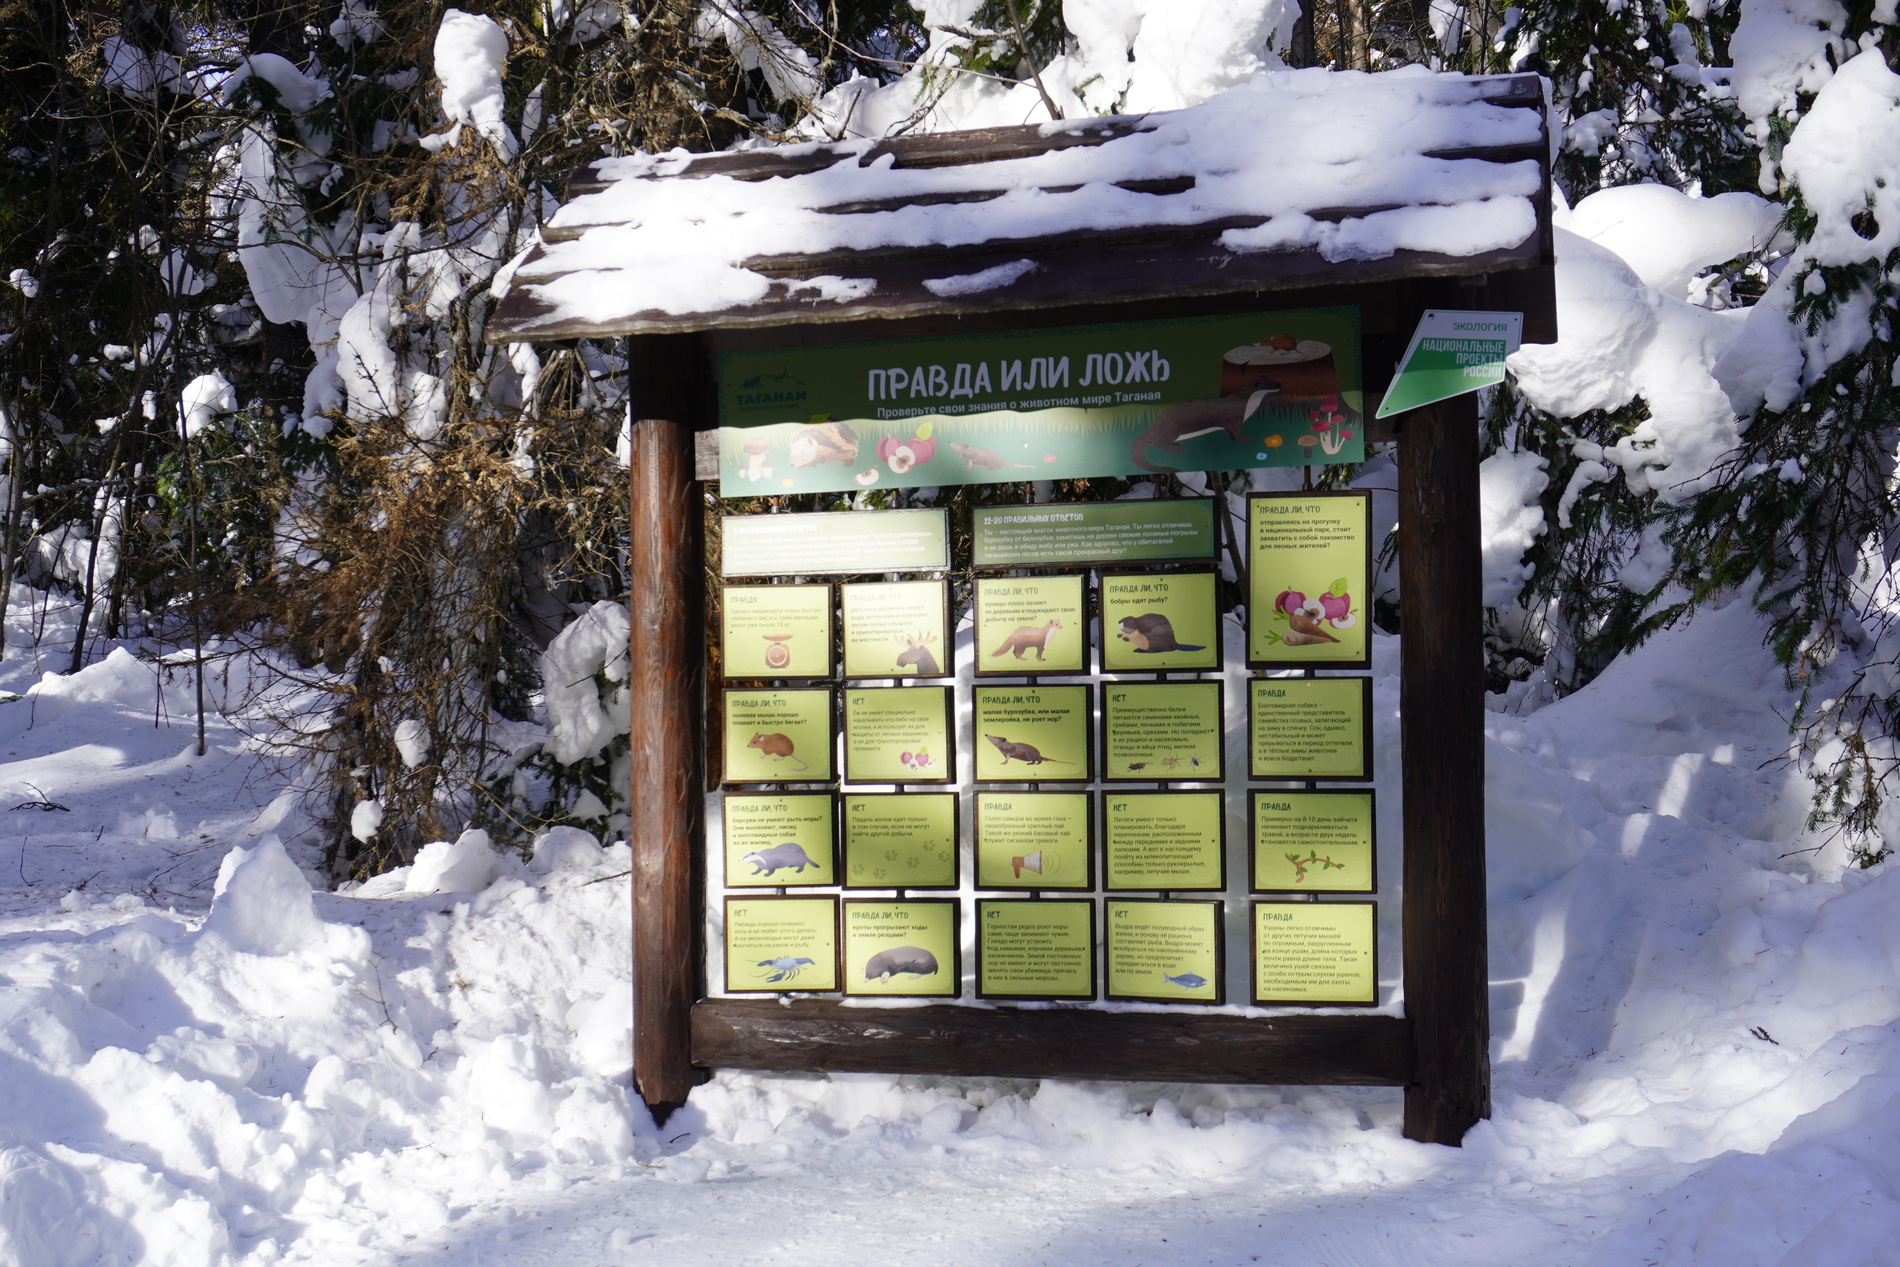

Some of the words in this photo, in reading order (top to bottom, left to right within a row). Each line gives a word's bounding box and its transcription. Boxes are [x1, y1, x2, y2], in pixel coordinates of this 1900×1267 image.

[1453, 322, 1507, 332] ЭКОЛОГИЯ
[1423, 339, 1504, 353] НАЦИОНАЛЬНЫЕ
[1456, 353, 1502, 365] ПРОЕКТЫ
[869, 362, 992, 400] ПРАВДА
[1001, 356, 1069, 391] ИЛИ
[1079, 350, 1170, 386] ЛОЖЬ
[1464, 366, 1502, 378] РОССИИ
[878, 407, 936, 418] Проверьте
[939, 405, 965, 414] свои
[968, 402, 1007, 411] знания
[1020, 397, 1078, 408] животном
[1082, 395, 1111, 405] мире
[1114, 392, 1161, 402] Таганая
[1292, 506, 1304, 514] ЛИ,
[984, 516, 1002, 525] 11-20
[1004, 515, 1049, 524] ПРАВИЛЬНЫХ
[1050, 514, 1083, 522] ОТВЕТОВ
[999, 526, 1032, 536] настоящий
[1106, 523, 1131, 531] Таганая.
[1265, 526, 1313, 534] национальный
[984, 534, 1013, 544] бурозубку
[1022, 533, 1055, 543] белозубки,
[1170, 530, 1198, 538] погрызы
[1020, 541, 1037, 551] обиду
[1038, 541, 1053, 550] жабу
[1138, 537, 1174, 545] обитателей
[984, 550, 1020, 558] таганайских
[1055, 548, 1072, 556] такой
[1073, 547, 1110, 557] прекрасный
[1111, 546, 1127, 556] друг!
[1012, 588, 1024, 596] ЛИ,
[1140, 584, 1152, 593] ЛИ,
[1110, 597, 1131, 605] бобры
[1148, 596, 1168, 604] рыбу?
[985, 615, 1007, 623] добычу
[1013, 696, 1025, 704] ЛИ,
[1003, 708, 1037, 716] бурозубка,
[762, 718, 784, 727] быстро
[983, 716, 1021, 724] землеройка,
[1047, 715, 1061, 723] нор?
[761, 805, 772, 813] ЛИ,
[1261, 803, 1291, 811] ПРАВДА
[882, 912, 893, 920] ЛИ,
